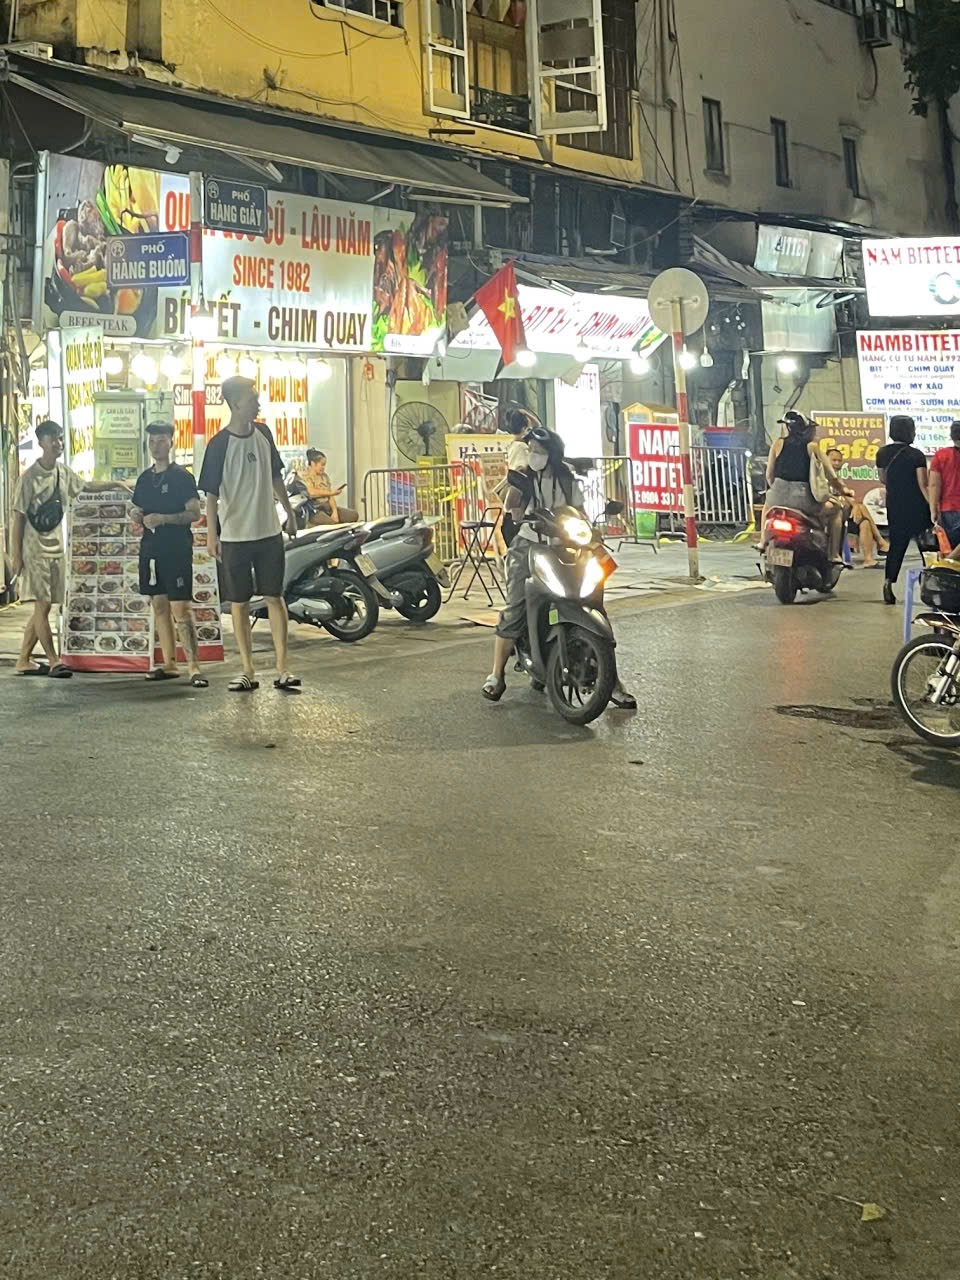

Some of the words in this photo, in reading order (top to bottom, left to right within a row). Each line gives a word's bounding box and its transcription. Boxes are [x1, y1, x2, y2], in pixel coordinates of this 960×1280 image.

[231, 189, 250, 201] PHỐ
[210, 200, 237, 222] HÀNG
[301, 201, 331, 252] LÂU
[336, 210, 371, 256] NĂM
[141, 238, 165, 253] PHỐ
[111, 260, 146, 281] HÀNG
[149, 252, 187, 278] BUỒM
[866, 247, 902, 266] NAM
[232, 254, 275, 289] SINCE
[279, 261, 311, 293] 1982
[267, 305, 317, 343] CHIM
[323, 309, 368, 347] QUAY
[859, 333, 960, 352] NAMBITTET
[204, 385, 223, 404] 982
[815, 416, 840, 427] VIET
[842, 417, 883, 429] COFFEE
[828, 428, 871, 437] BALCONY
[638, 429, 680, 456] NAM
[632, 460, 685, 489] BITTET
